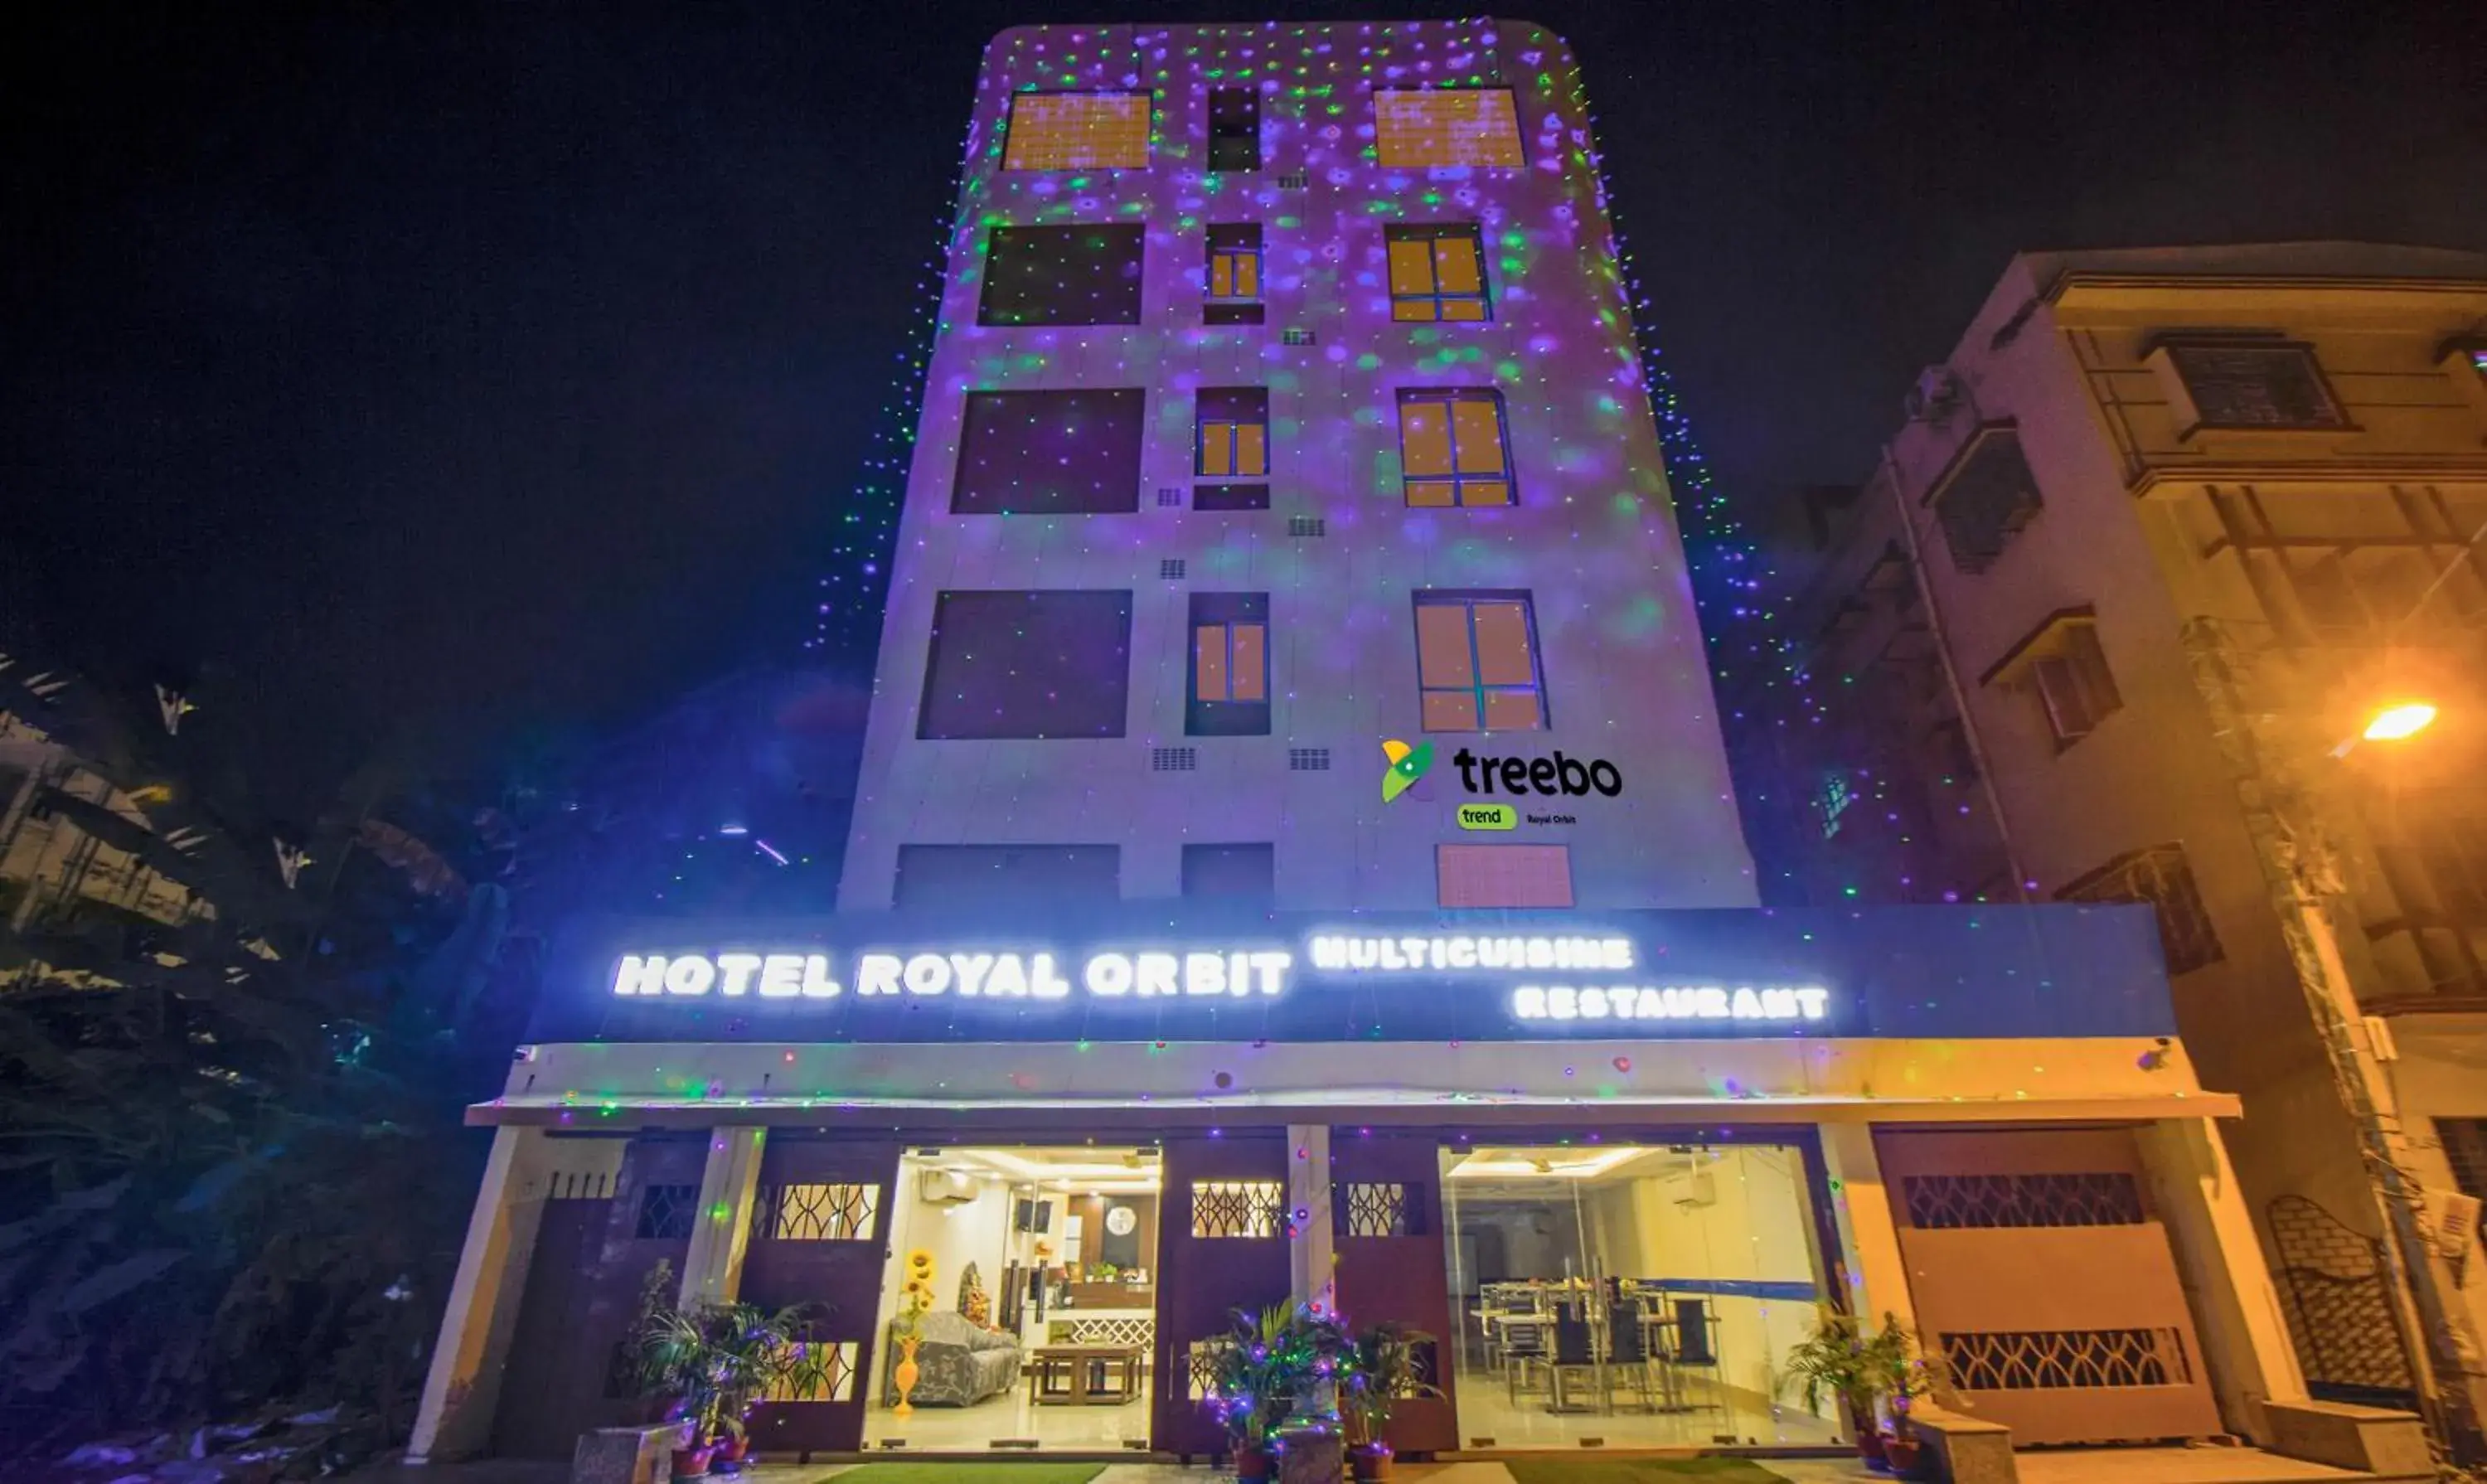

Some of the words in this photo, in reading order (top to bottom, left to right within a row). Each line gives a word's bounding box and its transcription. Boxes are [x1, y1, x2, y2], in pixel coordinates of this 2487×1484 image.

[1453, 748, 1622, 797] treebo
[1462, 808, 1501, 823] trend
[1527, 813, 1551, 827] Royal
[1311, 937, 1633, 969] MULTICUISINE
[614, 955, 840, 997] HOTEL
[857, 953, 1069, 997] ROYAL
[1086, 952, 1292, 997] ORBIT
[1514, 987, 1828, 1020] RESTAURANT
